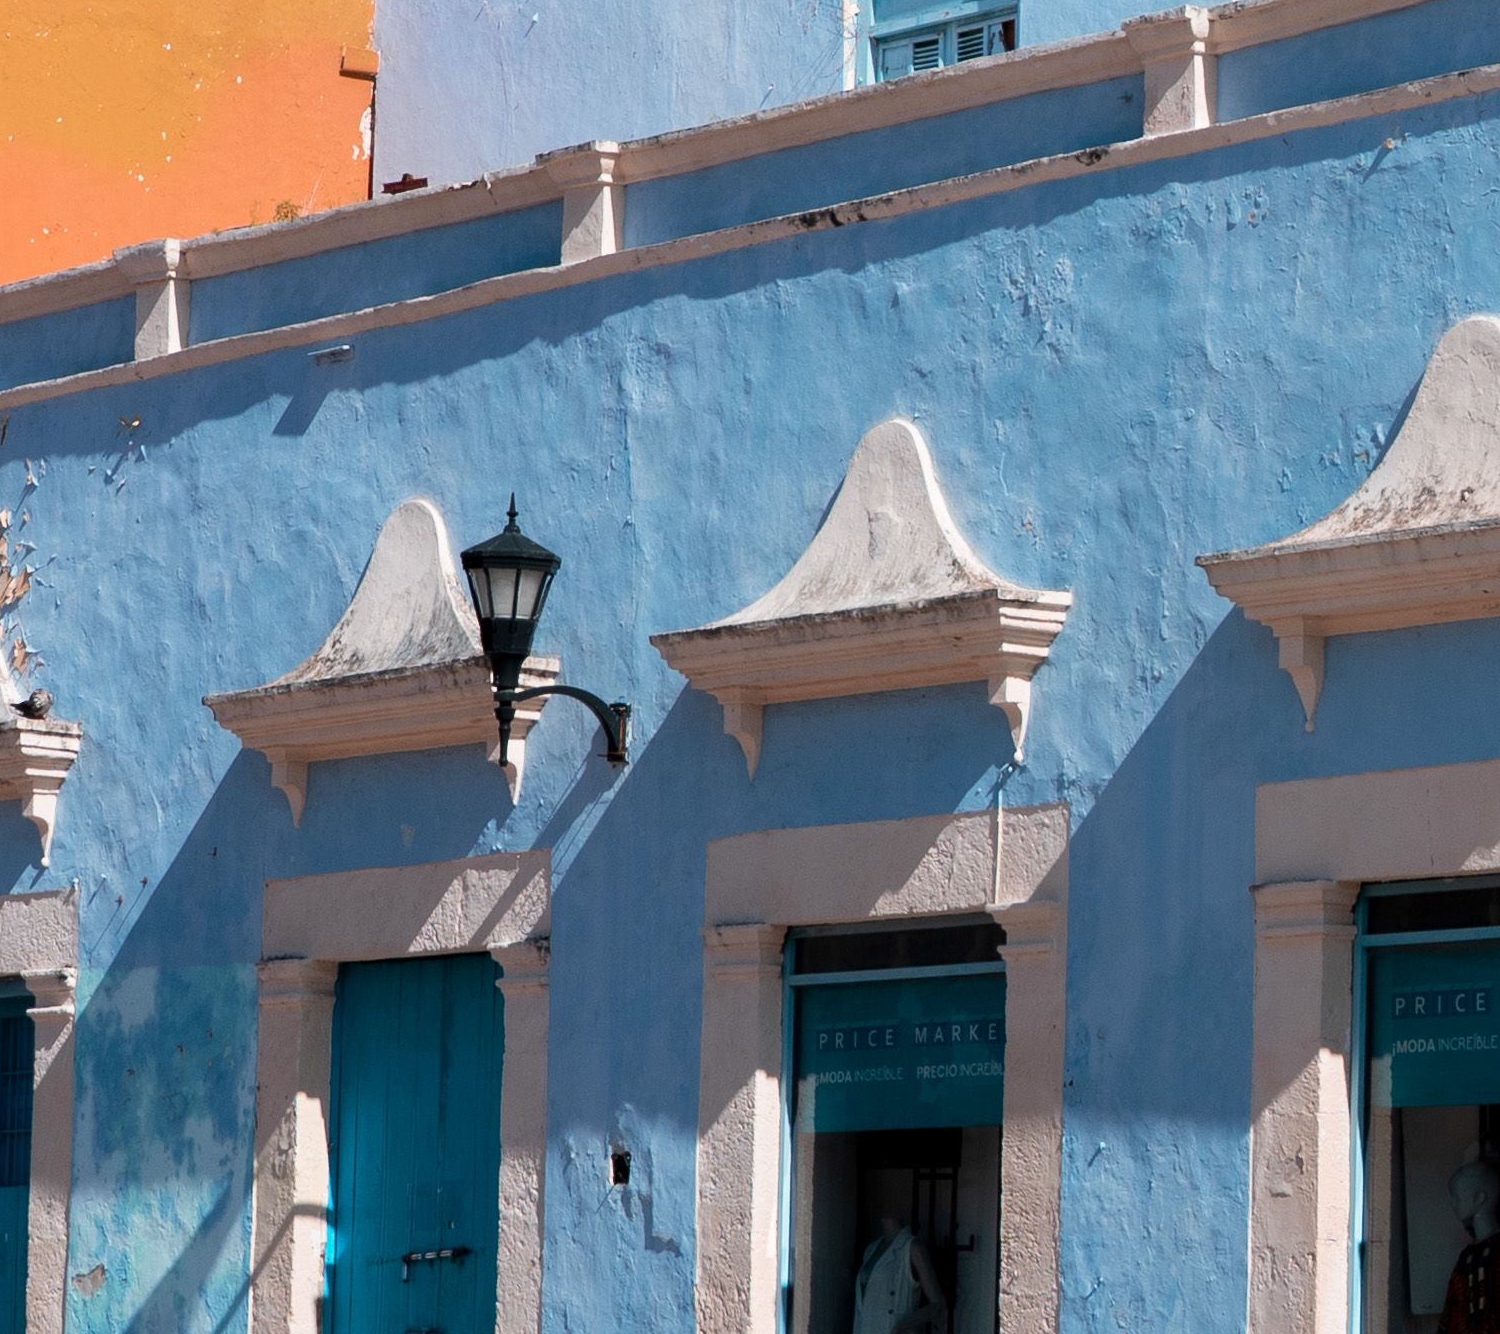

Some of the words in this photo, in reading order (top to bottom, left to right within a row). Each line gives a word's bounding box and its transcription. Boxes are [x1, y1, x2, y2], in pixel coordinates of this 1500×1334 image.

[1395, 992, 1487, 1016] PRICE
[819, 1029, 895, 1050] PRICE
[1392, 1038, 1436, 1057] ¡MODA
[1437, 1032, 1499, 1051] INCREÍBLE
[916, 1064, 957, 1080] PRECIO
